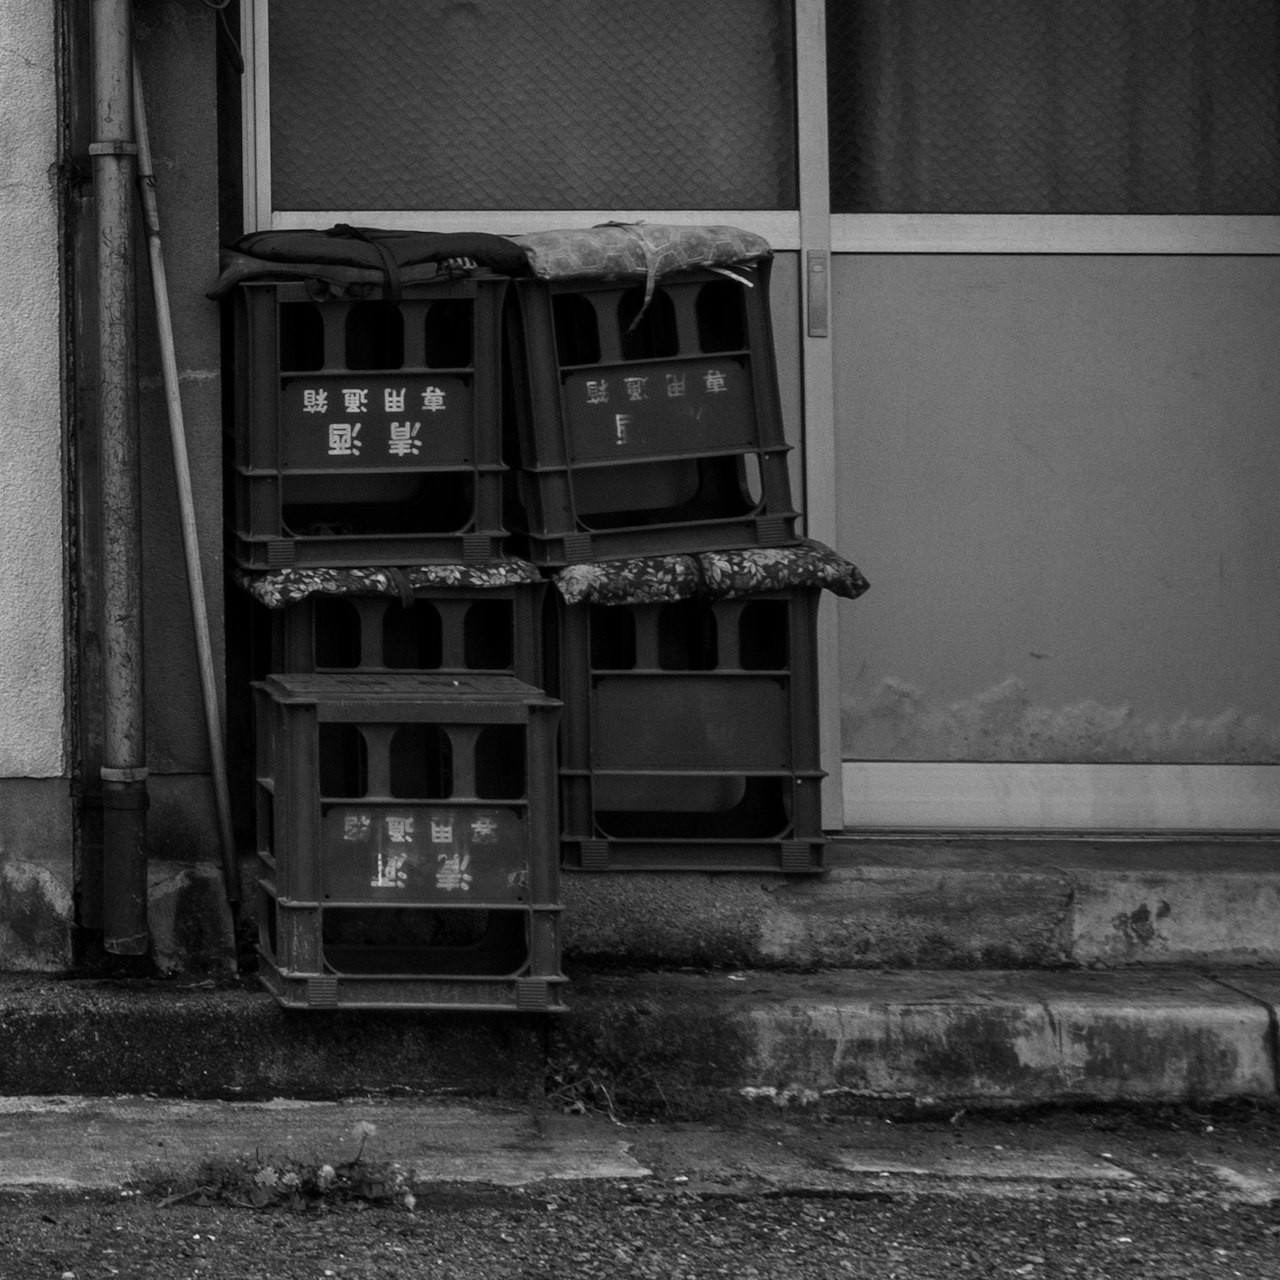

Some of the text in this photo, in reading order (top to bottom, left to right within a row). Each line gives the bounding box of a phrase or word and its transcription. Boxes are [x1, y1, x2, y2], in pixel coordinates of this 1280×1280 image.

[302, 387, 447, 414] 専用通箱
[328, 421, 423, 456] 清酒
